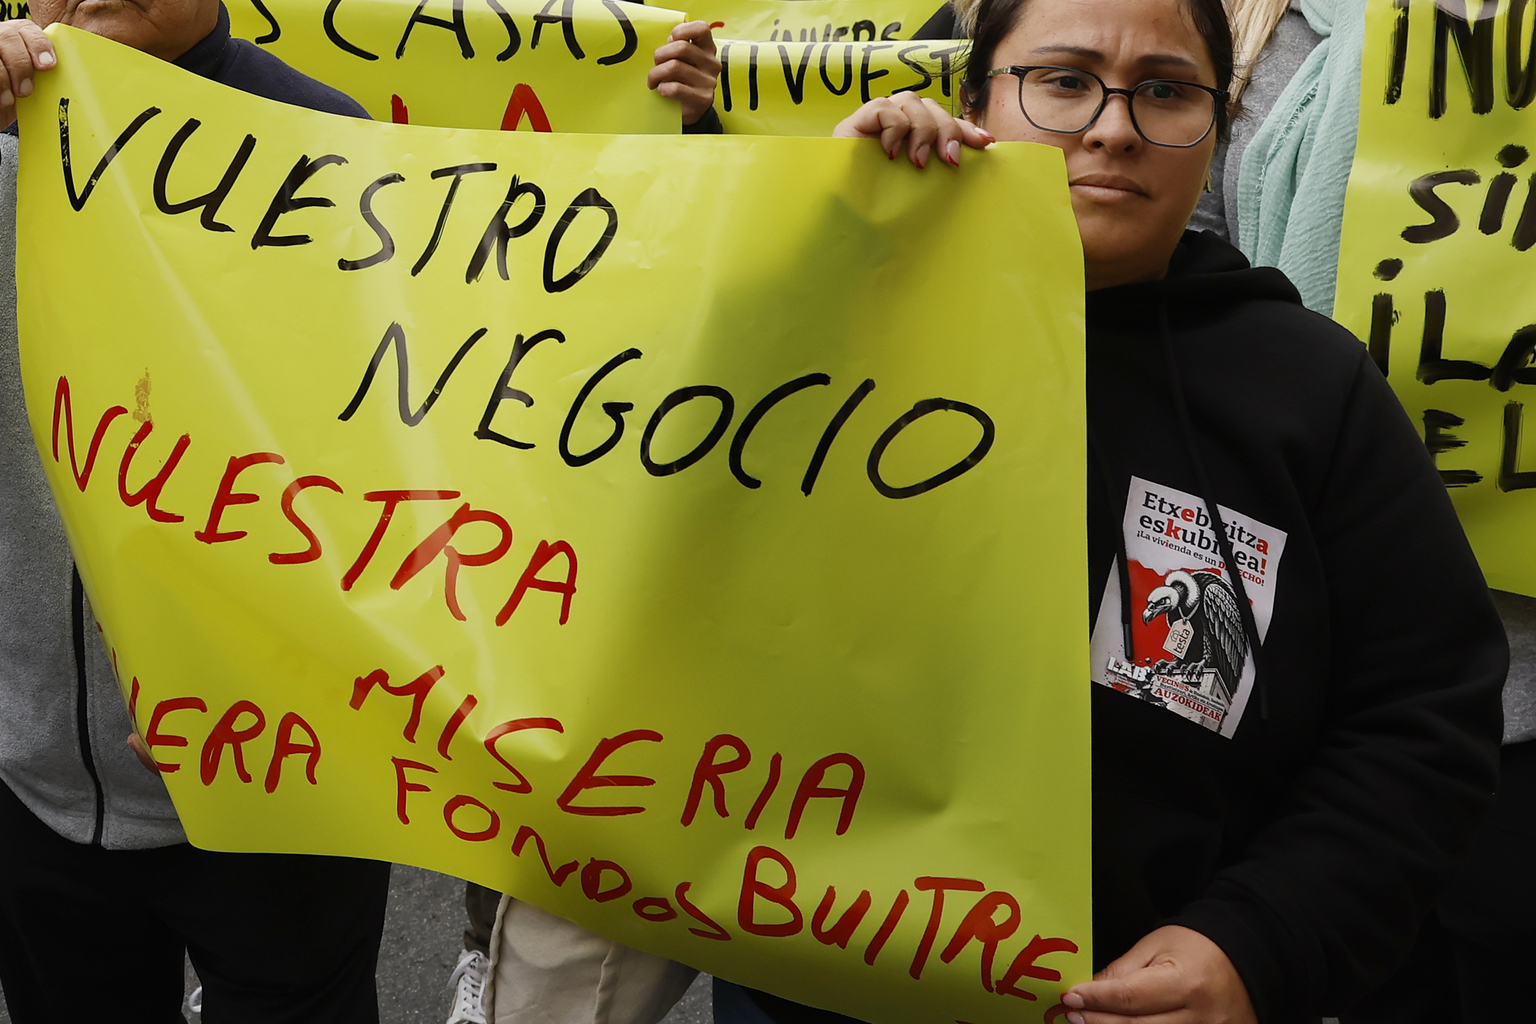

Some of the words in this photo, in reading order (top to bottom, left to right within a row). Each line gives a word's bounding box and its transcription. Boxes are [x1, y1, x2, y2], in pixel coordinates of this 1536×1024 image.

[58, 97, 620, 294] VUESTRO
[337, 320, 996, 500] NEGOCIO
[51, 374, 580, 627] NUESTRA
[1136, 529, 1152, 540] ¡La
[1152, 535, 1193, 557] vivienda
[1193, 552, 1204, 562] es
[1205, 556, 1217, 567] un
[1154, 687, 1222, 722] AUZOKIDEAK
[1173, 628, 1191, 654] testa
[348, 664, 866, 840] MISERIA
[737, 844, 1080, 1002] BUITRE
